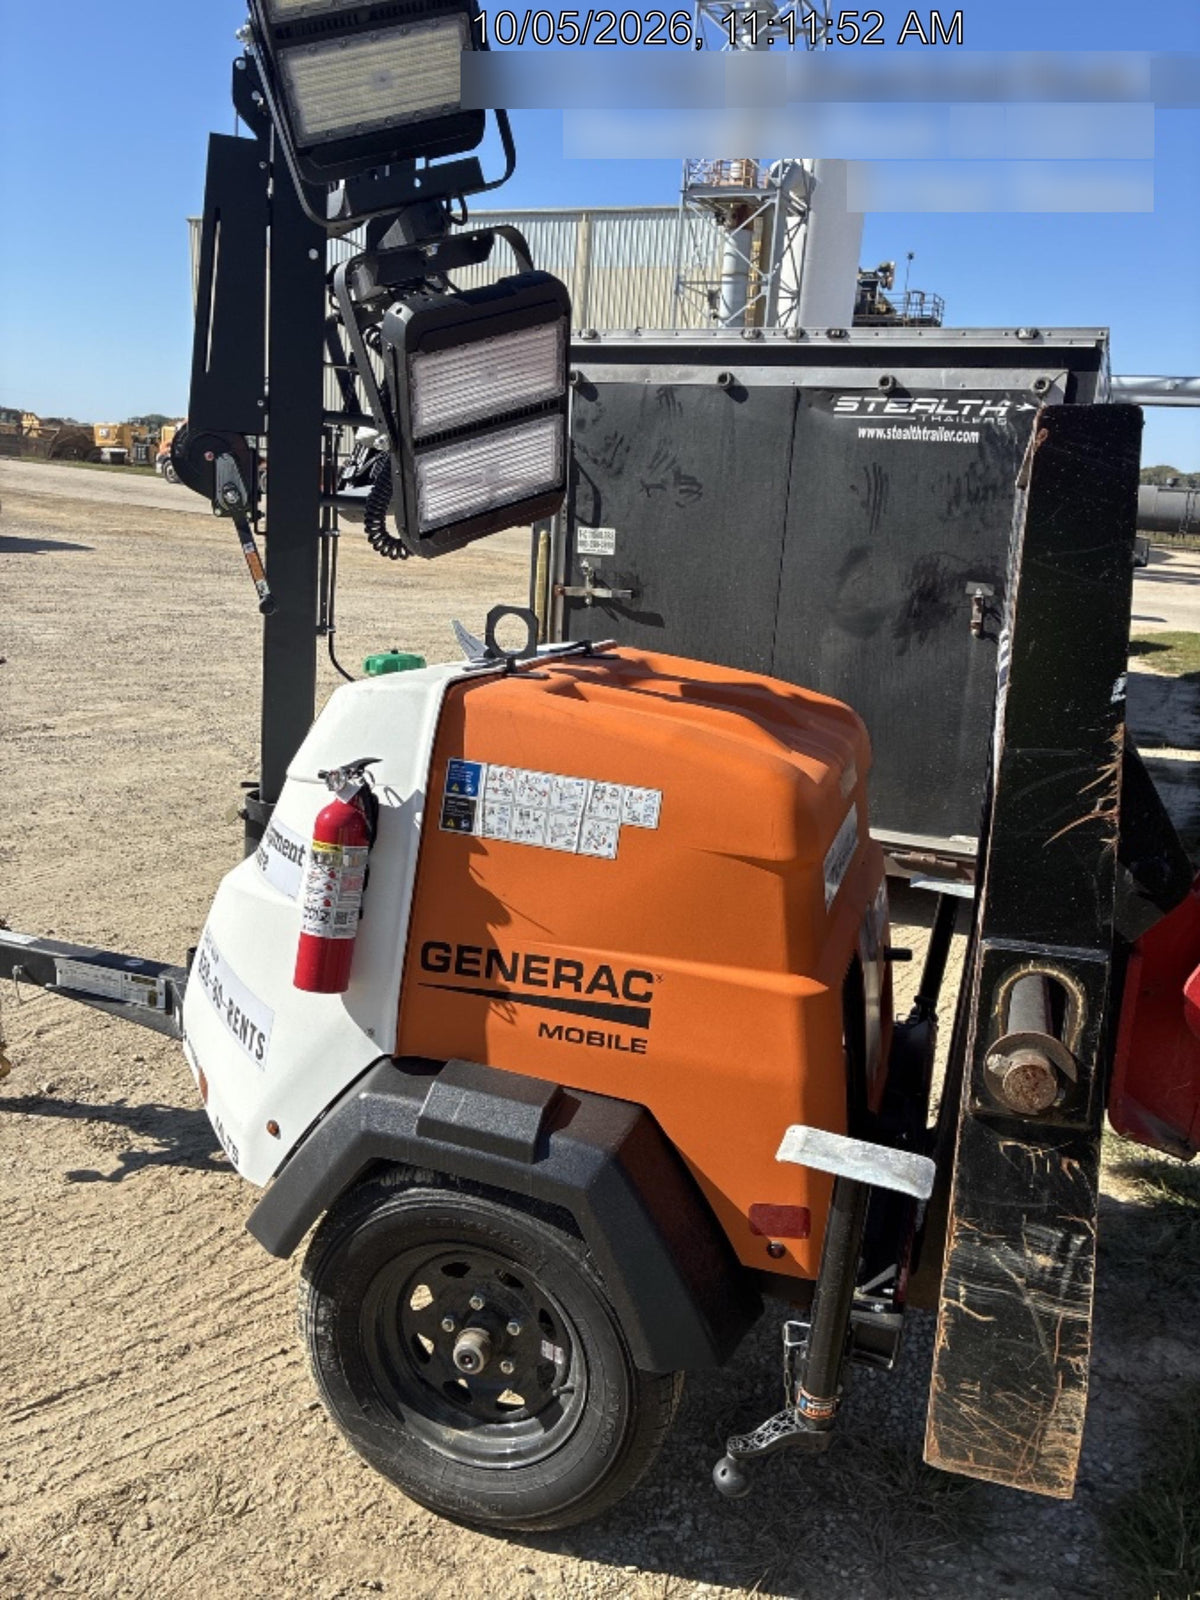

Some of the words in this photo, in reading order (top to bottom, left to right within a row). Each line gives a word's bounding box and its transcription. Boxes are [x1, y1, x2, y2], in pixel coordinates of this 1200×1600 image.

[833, 395, 1011, 417] STEALTH
[857, 424, 980, 444] www.stealthtrailer.com
[421, 940, 656, 1004] GENERAC
[538, 1022, 648, 1055] MOBILE
